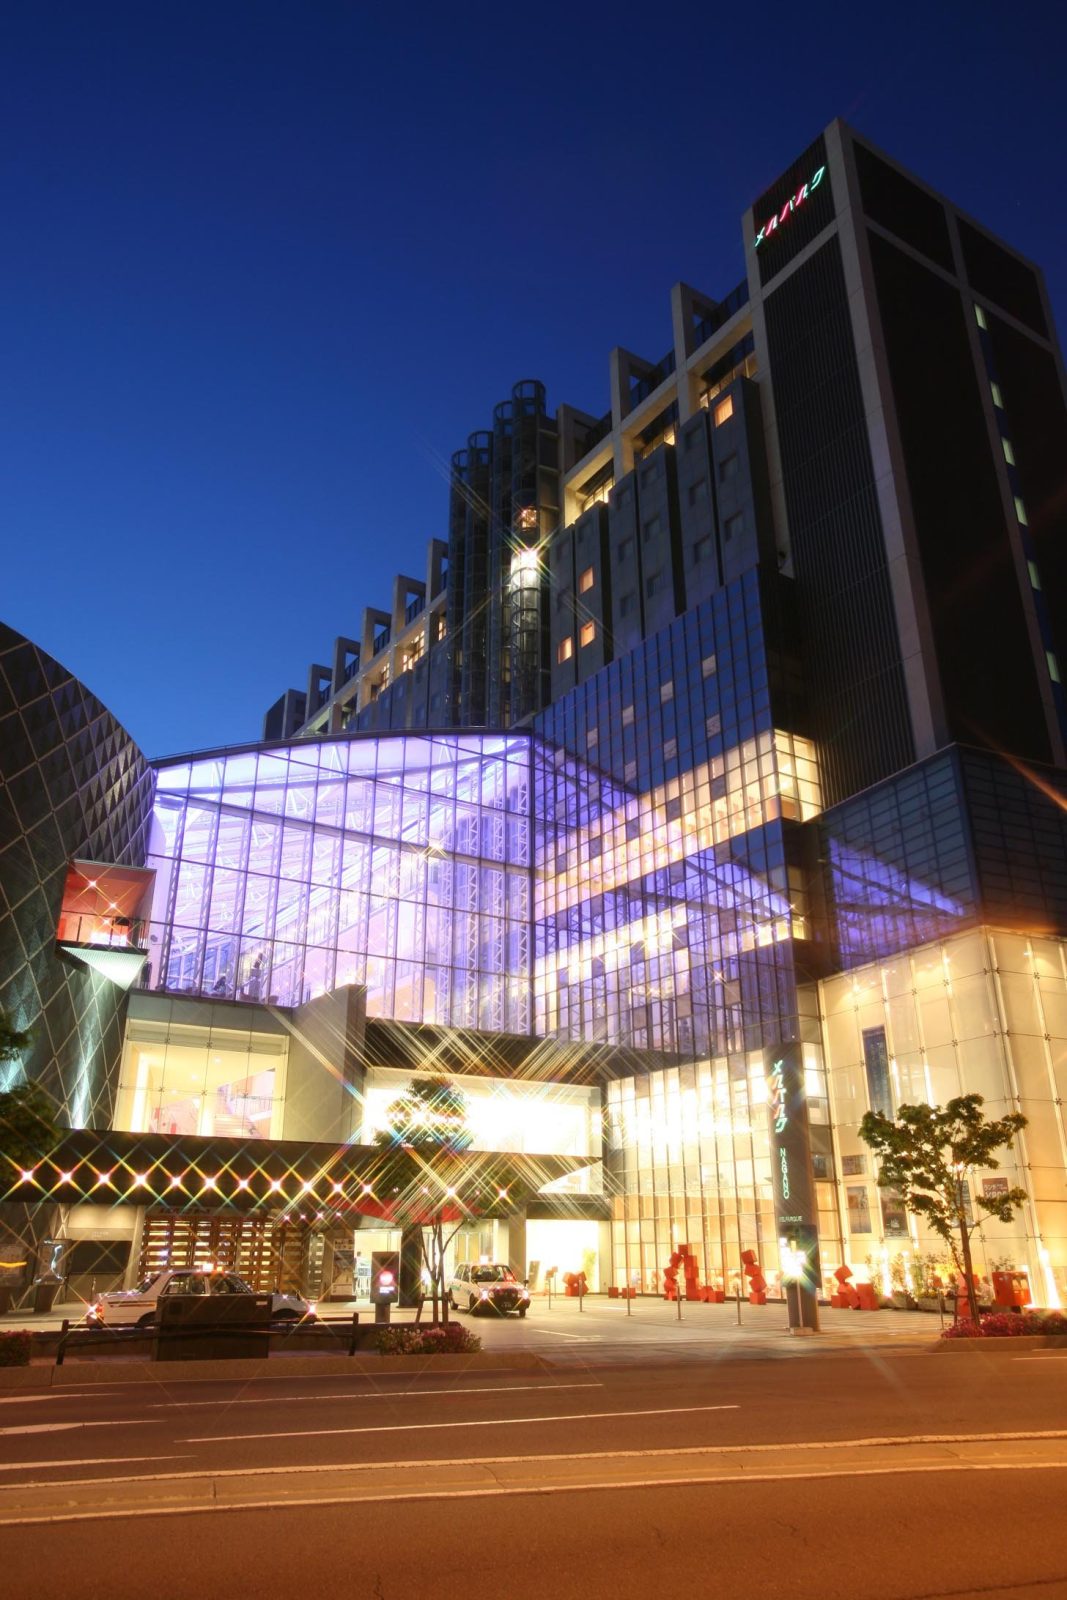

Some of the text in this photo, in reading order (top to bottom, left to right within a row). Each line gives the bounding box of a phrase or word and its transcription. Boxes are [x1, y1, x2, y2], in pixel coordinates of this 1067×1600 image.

[754, 166, 825, 247] メルパルク
[780, 1148, 790, 1200] NAGANO
